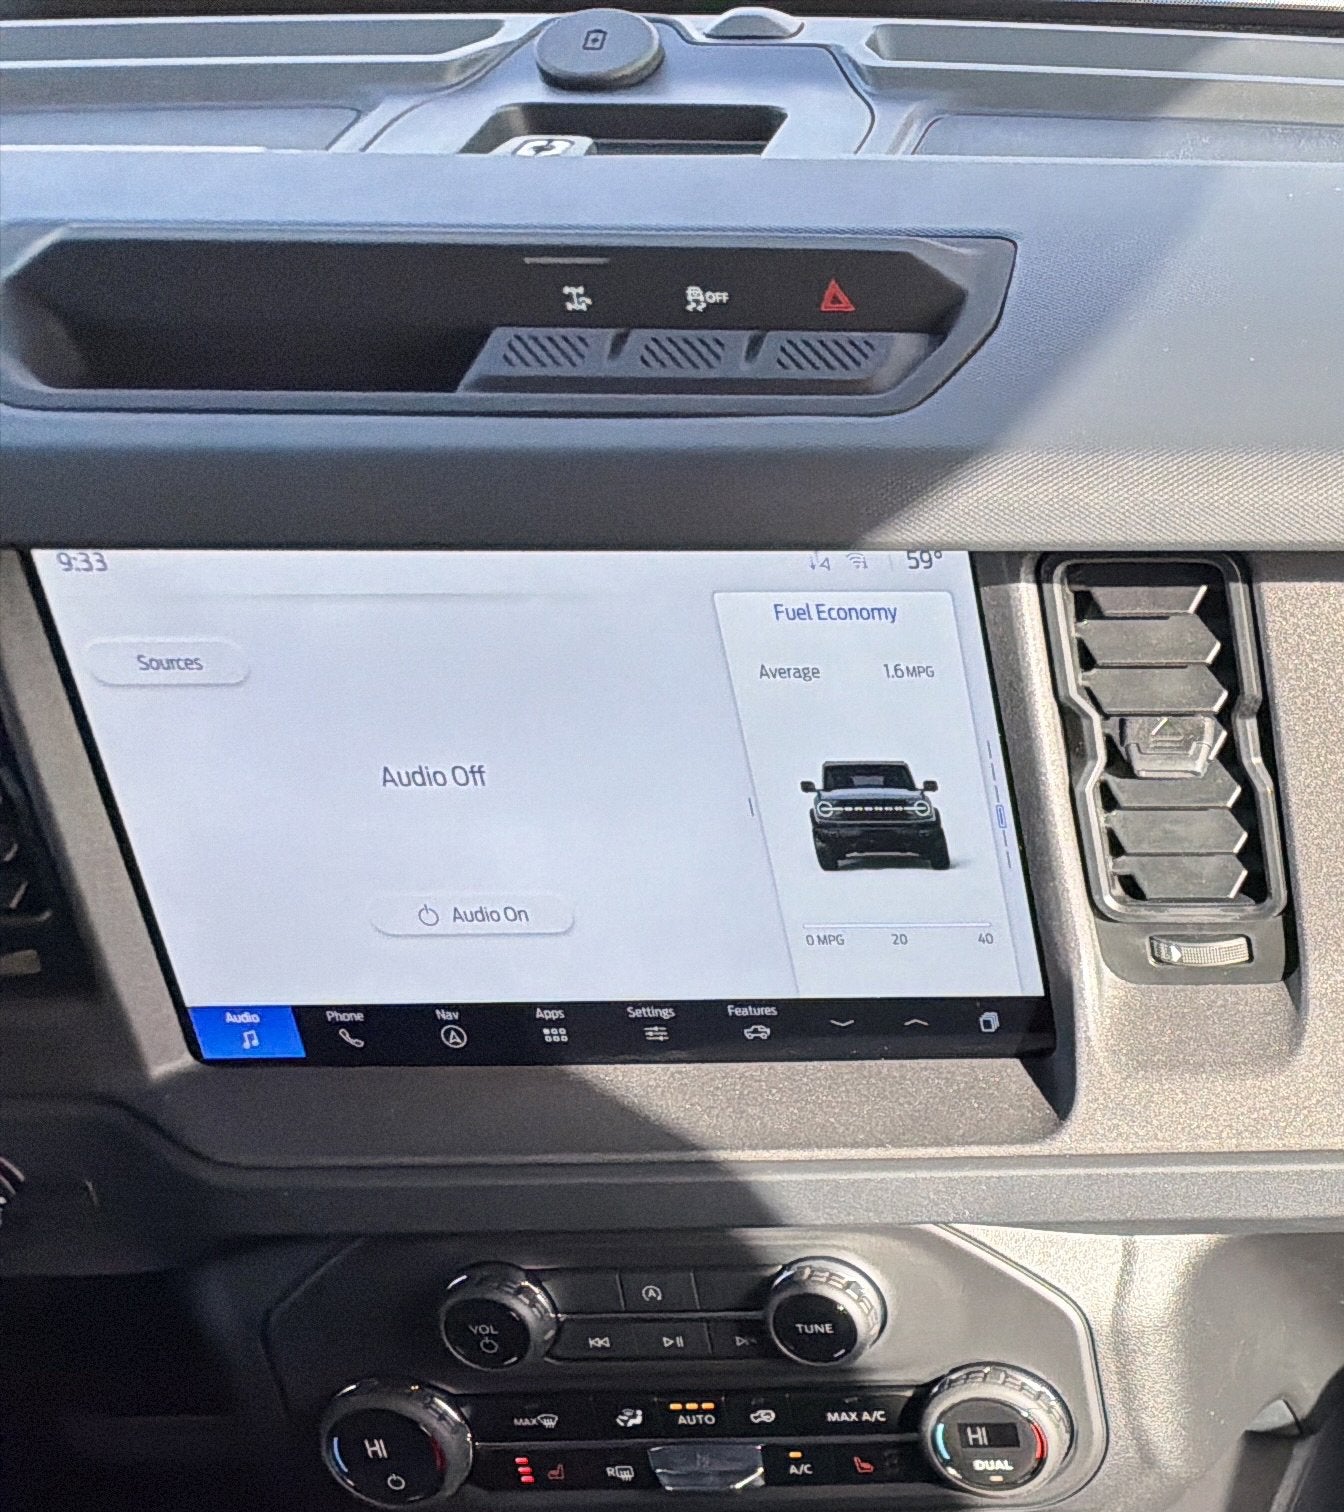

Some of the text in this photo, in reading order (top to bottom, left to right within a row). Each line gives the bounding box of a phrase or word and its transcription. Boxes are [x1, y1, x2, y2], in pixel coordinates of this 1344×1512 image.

[704, 290, 729, 304] OFF
[56, 551, 108, 572] 9:33
[773, 603, 897, 624] Fuel Economy
[136, 654, 204, 671] Sources
[759, 664, 821, 682] Average
[382, 765, 486, 787] Audio Off
[452, 906, 529, 923] Audio On
[817, 934, 845, 946] MPG
[891, 933, 908, 945] 20
[977, 933, 994, 945] 40
[325, 1010, 364, 1022] Phone
[435, 1008, 460, 1021] Nav
[535, 1007, 566, 1020] Apps
[626, 1006, 676, 1019] Settings
[727, 1004, 778, 1017] Features
[225, 1011, 261, 1024] Audio
[468, 1323, 499, 1336] VOL
[795, 1322, 834, 1335] TUNE
[513, 1417, 537, 1427] MAX
[677, 1414, 716, 1426] AUTO
[826, 1410, 887, 1423] MAX A/C
[966, 1426, 989, 1446] HI
[363, 1438, 388, 1460] HI
[789, 1464, 813, 1475] A/C
[972, 1459, 1014, 1471] DUAL
